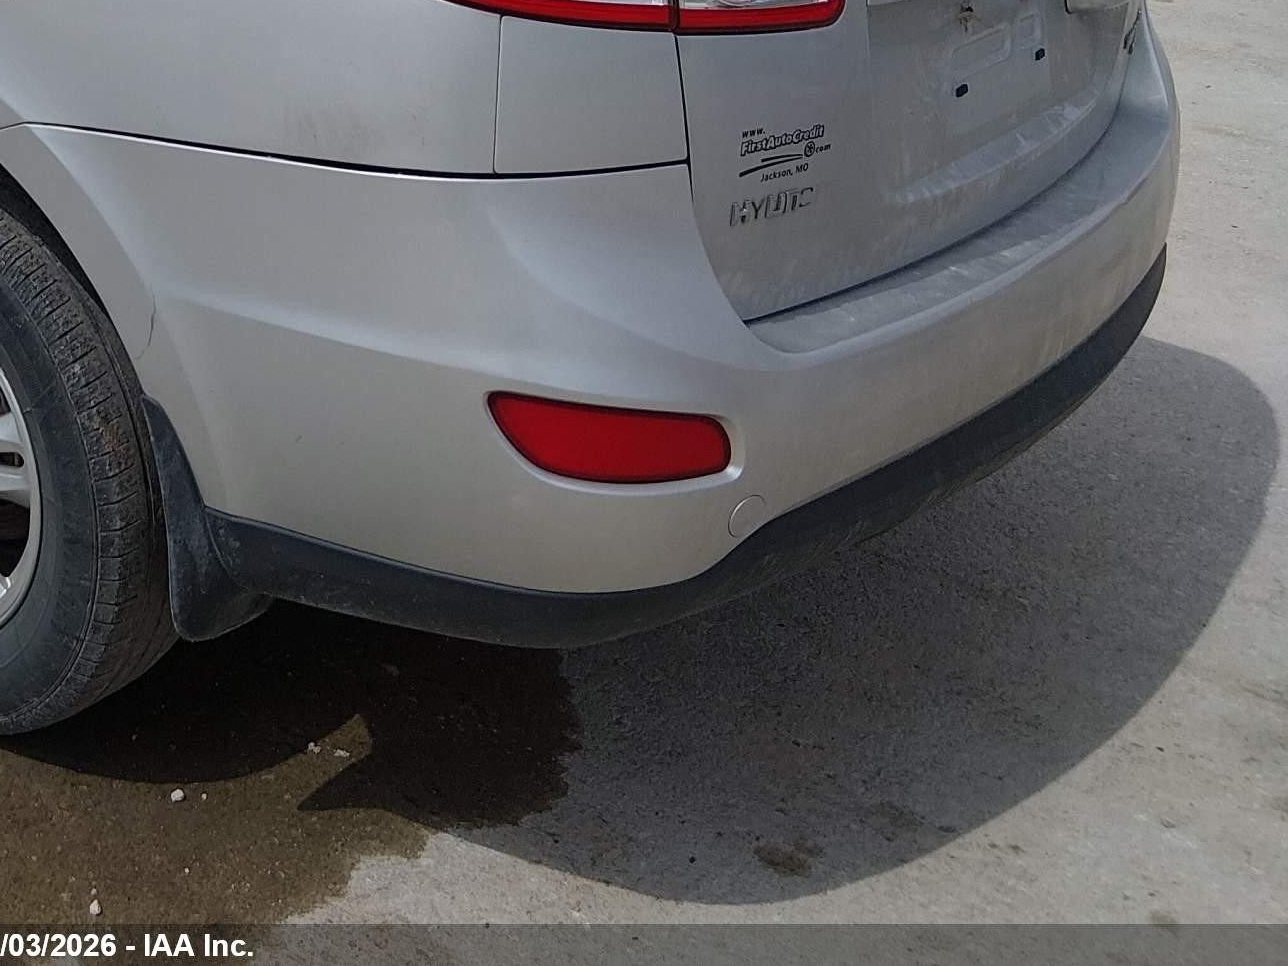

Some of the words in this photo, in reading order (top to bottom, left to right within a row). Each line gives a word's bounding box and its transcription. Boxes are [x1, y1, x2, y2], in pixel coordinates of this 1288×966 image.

[740, 124, 825, 156] FirstAutoCredit
[742, 128, 766, 138] www.
[760, 169, 793, 182] Jackson,
[795, 163, 809, 173] MO
